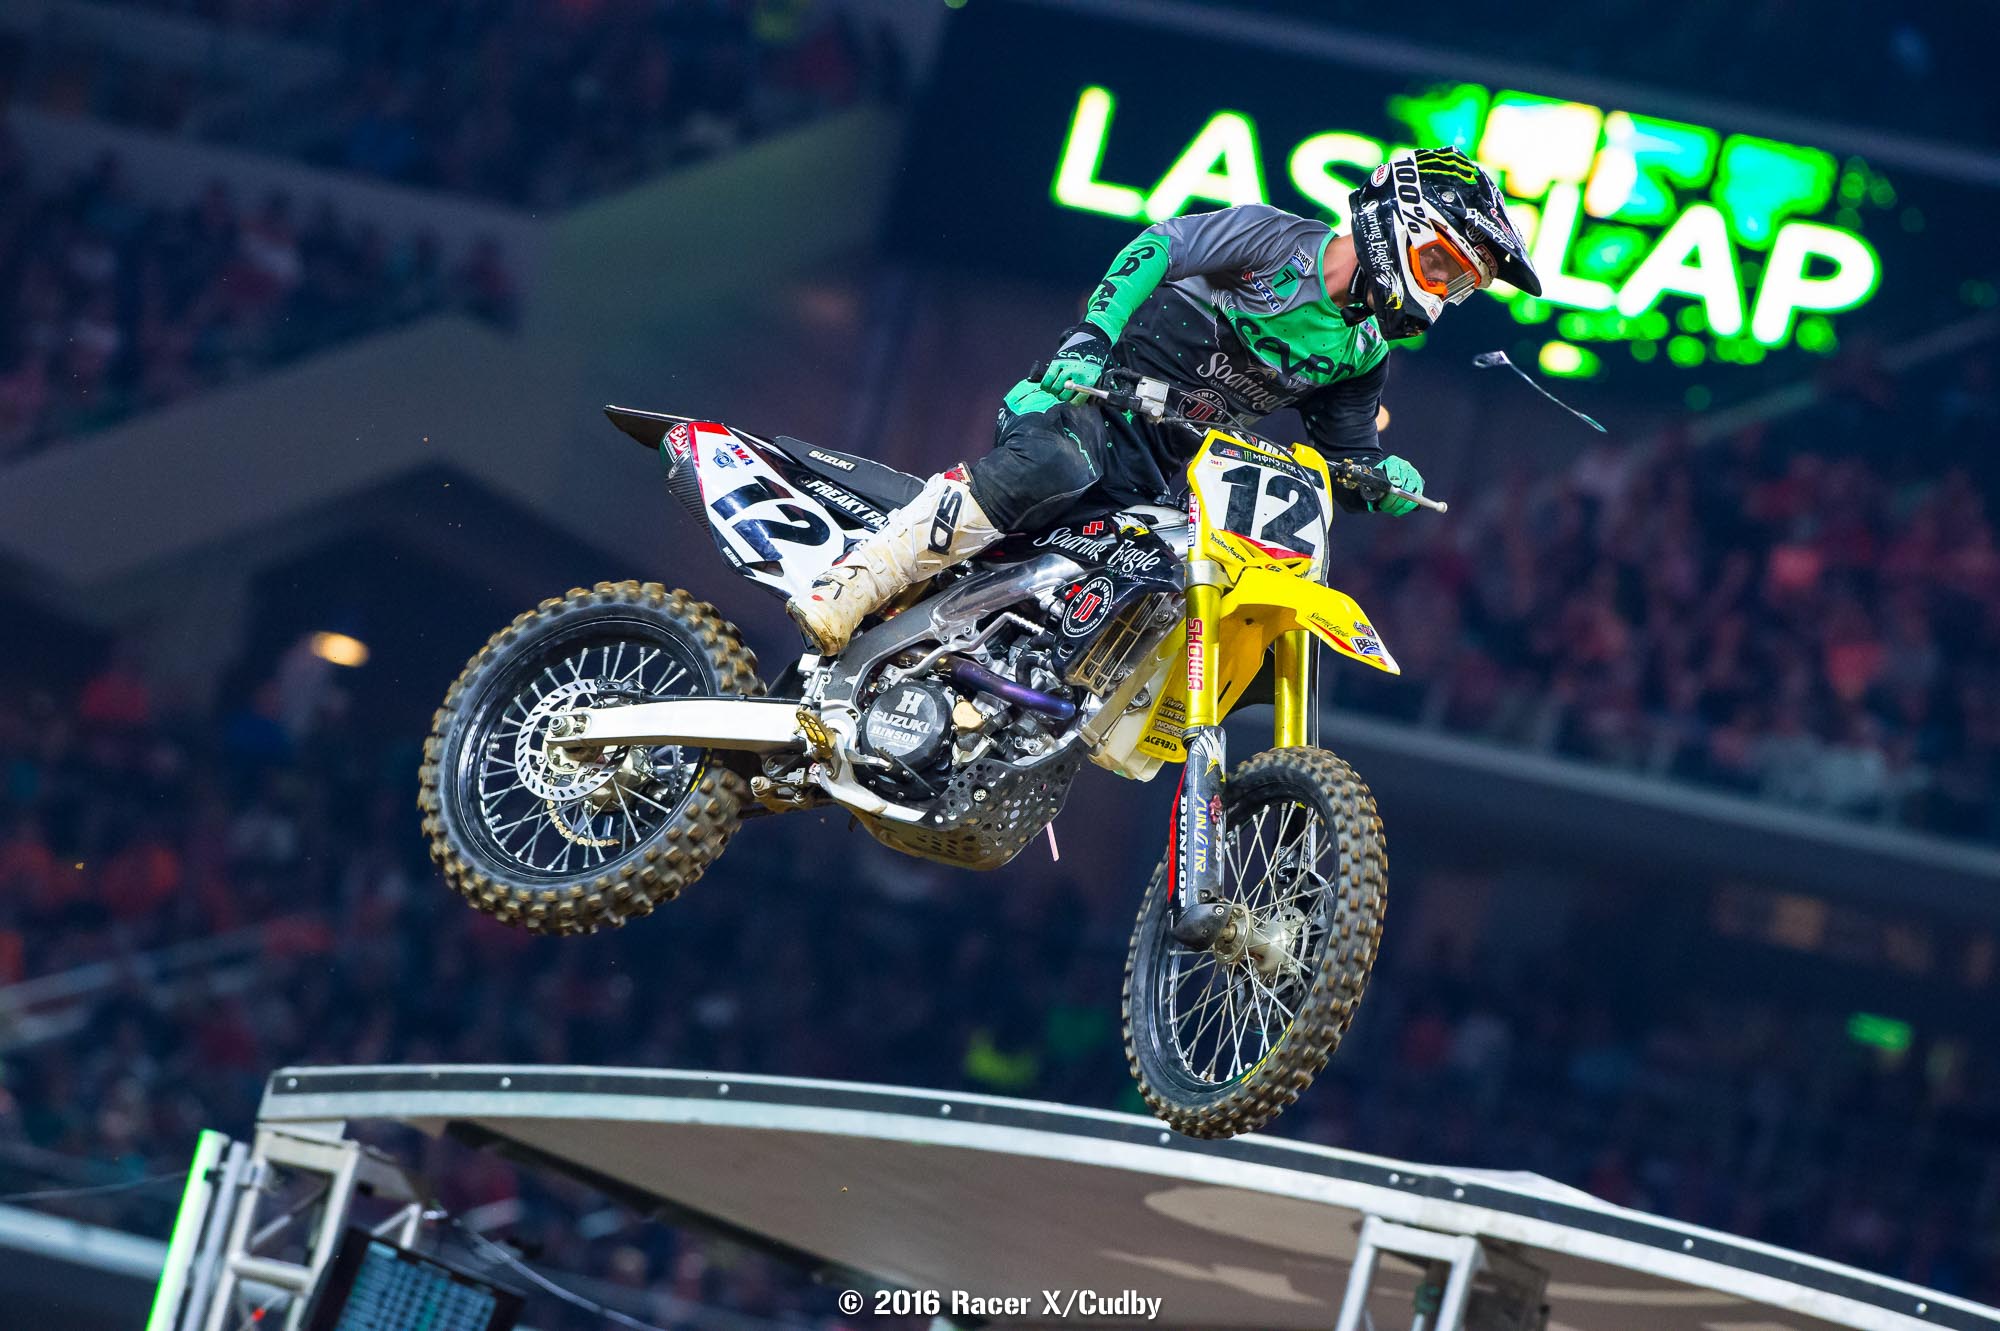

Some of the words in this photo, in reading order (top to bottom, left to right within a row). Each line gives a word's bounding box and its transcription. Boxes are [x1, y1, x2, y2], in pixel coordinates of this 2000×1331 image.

[1394, 157, 1432, 234] 100%
[1051, 85, 1408, 240] LAS
[1535, 182, 1881, 348] LAP
[1371, 241, 1396, 272] Eagle
[1252, 278, 1282, 311] SUZUKI
[1196, 352, 1279, 410] Soaring
[725, 443, 754, 466] AMA
[808, 450, 857, 471] SUZUKI
[1252, 453, 1298, 475] MONSTER
[710, 475, 830, 560] 12
[806, 480, 868, 517] FREAKY
[863, 510, 890, 528] FA
[1221, 465, 1320, 558] 12
[1033, 527, 1107, 561] Soaring
[1106, 539, 1161, 572] Eagle
[1188, 618, 1203, 691] SHOWA
[871, 711, 931, 734] SUZUKI
[871, 725, 921, 744] HINSON
[1158, 708, 1186, 723] HINSO
[1144, 735, 1177, 752] ACERBIS
[1178, 795, 1188, 908] DUNLOP
